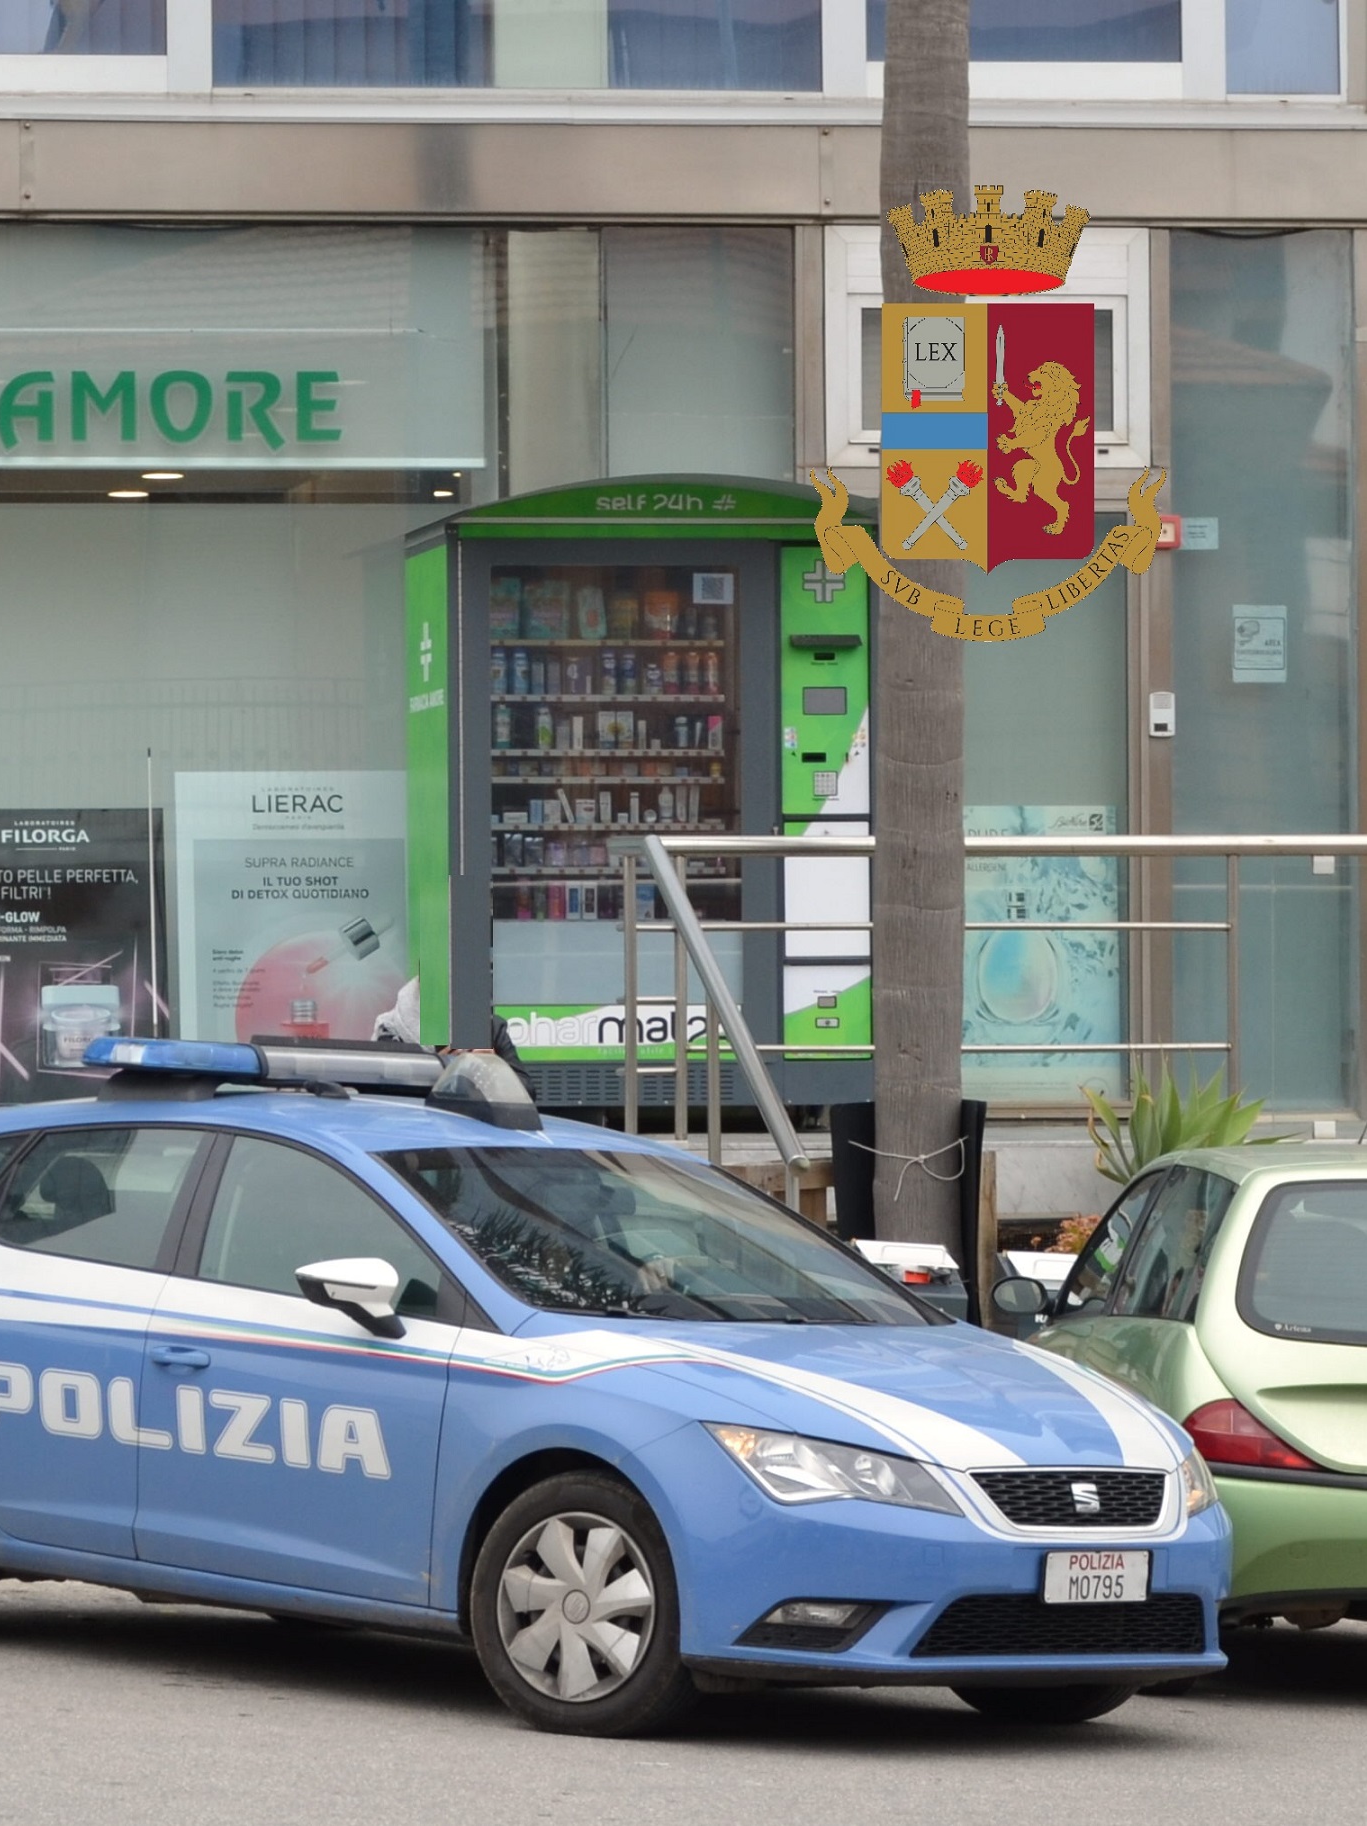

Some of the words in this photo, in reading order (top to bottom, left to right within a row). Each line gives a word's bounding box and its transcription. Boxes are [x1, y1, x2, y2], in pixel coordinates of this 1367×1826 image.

[596, 494, 646, 510] self
[252, 794, 343, 814] LIERAC
[1, 829, 90, 843] FILORGA
[245, 857, 287, 869] SUPRA
[291, 857, 354, 868] RADIANCE
[18, 869, 62, 884] PELLE
[66, 869, 139, 885] PERFETTA,
[263, 876, 273, 887] IL
[277, 876, 302, 887] TUO
[305, 876, 339, 887] SHOT
[231, 889, 244, 900] DI
[248, 889, 289, 900] DETOX
[292, 888, 369, 900] QUOTIDIANO
[1069, 1554, 1125, 1570] POLIZIA
[1068, 1575, 1124, 1600] M0795
